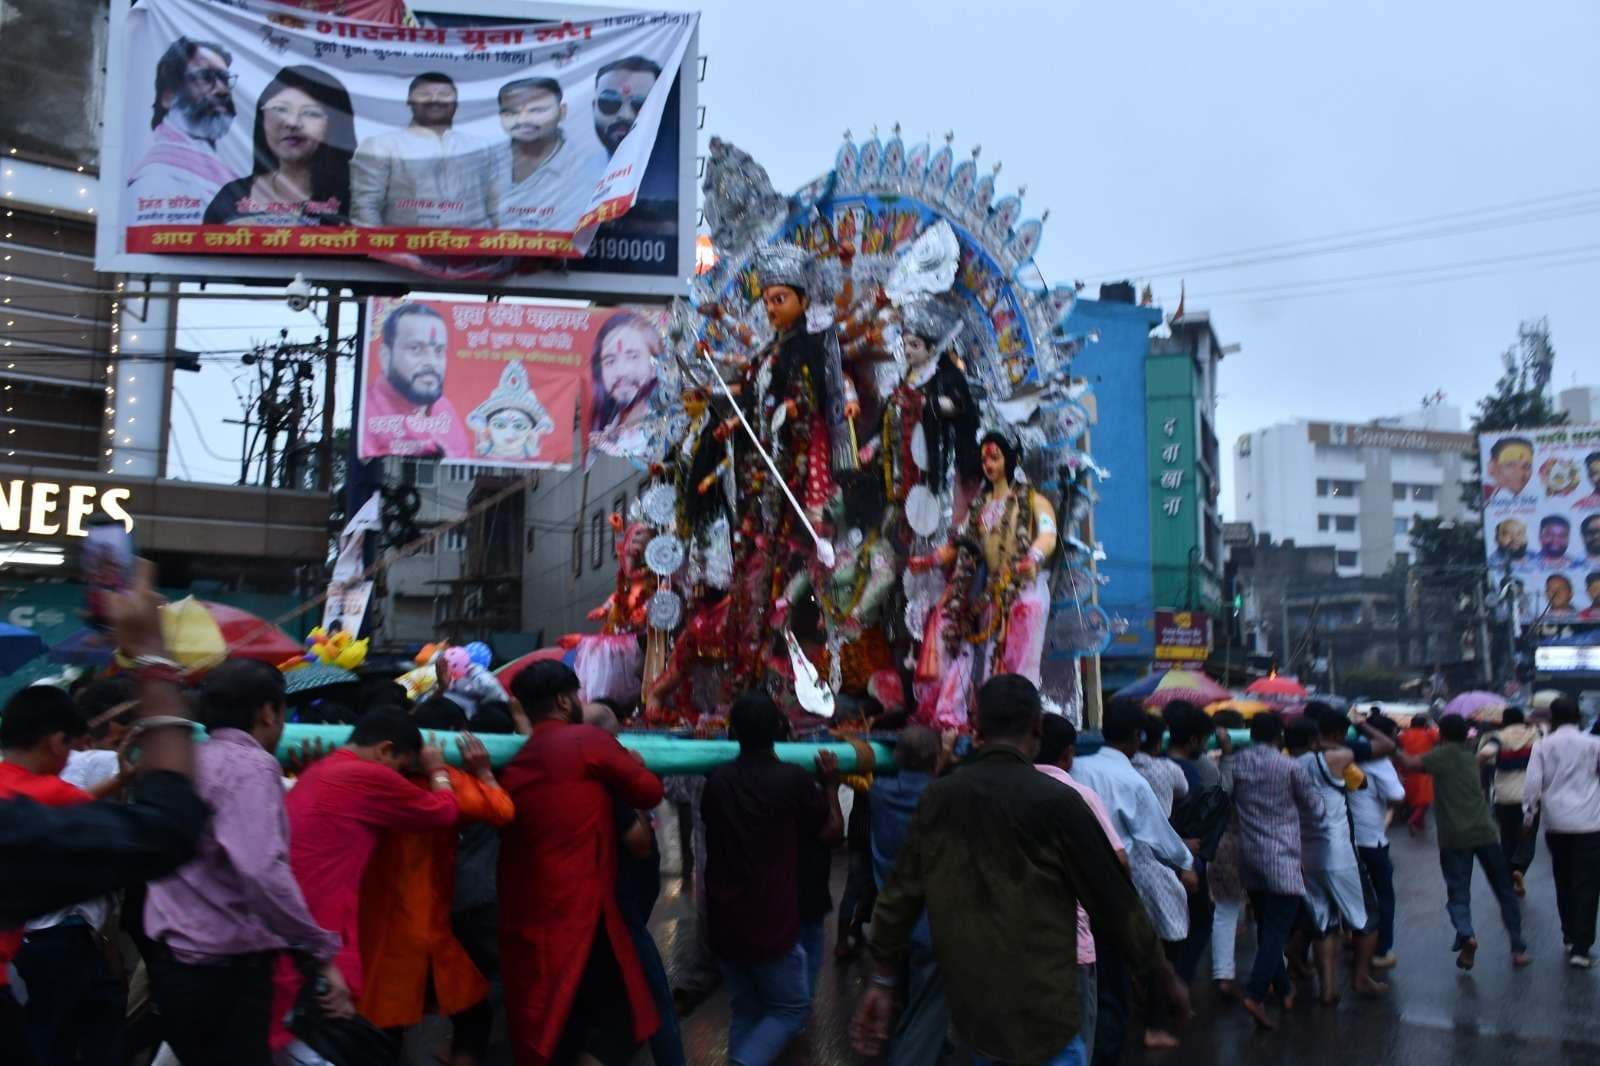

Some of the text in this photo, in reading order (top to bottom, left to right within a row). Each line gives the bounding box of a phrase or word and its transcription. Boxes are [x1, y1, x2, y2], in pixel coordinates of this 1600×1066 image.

[151, 231, 196, 247] आप
[203, 228, 254, 247] सभी
[368, 232, 398, 248] का
[406, 230, 473, 250] हार्दिक
